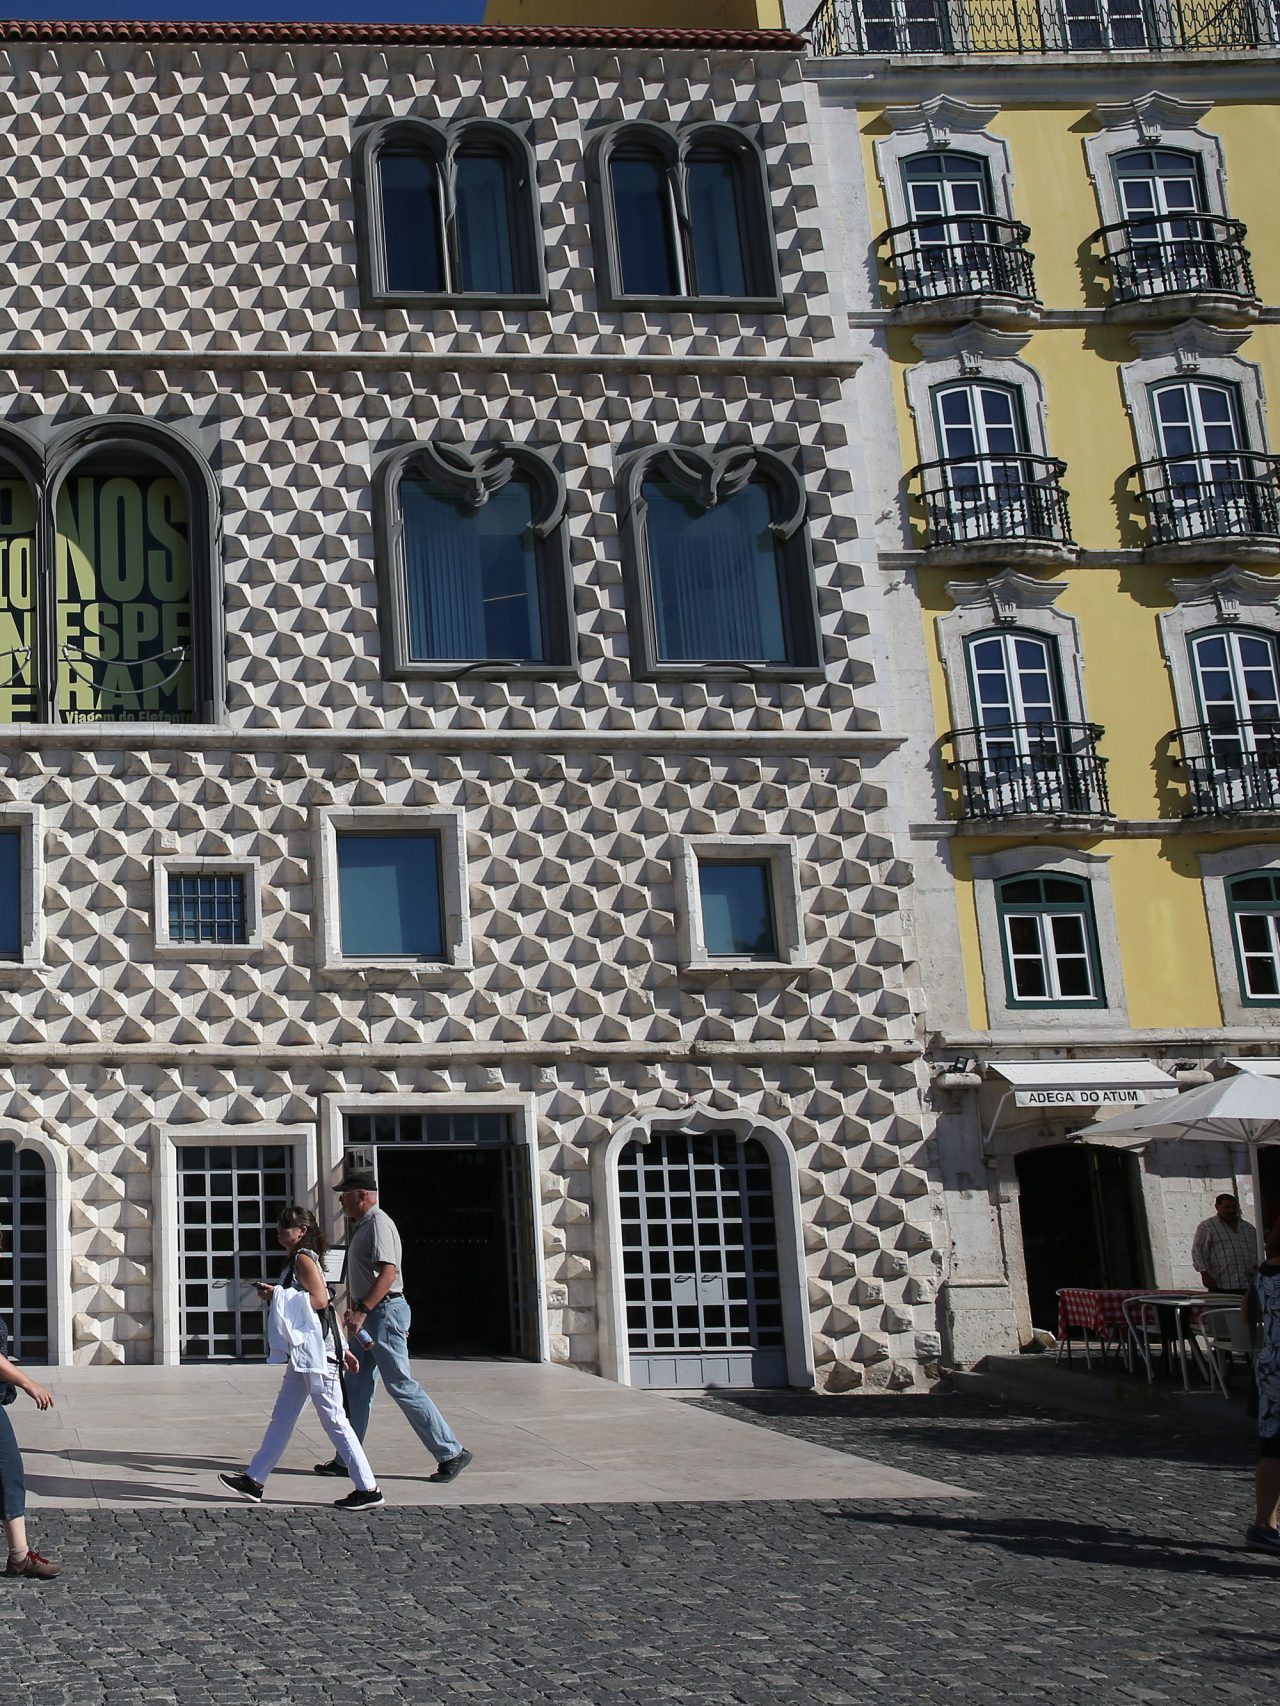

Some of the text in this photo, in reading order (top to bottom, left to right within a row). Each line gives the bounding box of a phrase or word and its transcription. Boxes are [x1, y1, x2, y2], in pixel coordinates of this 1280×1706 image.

[56, 477, 190, 602] NOS
[1028, 1091, 1138, 1103] ADEGA DO ATUM
